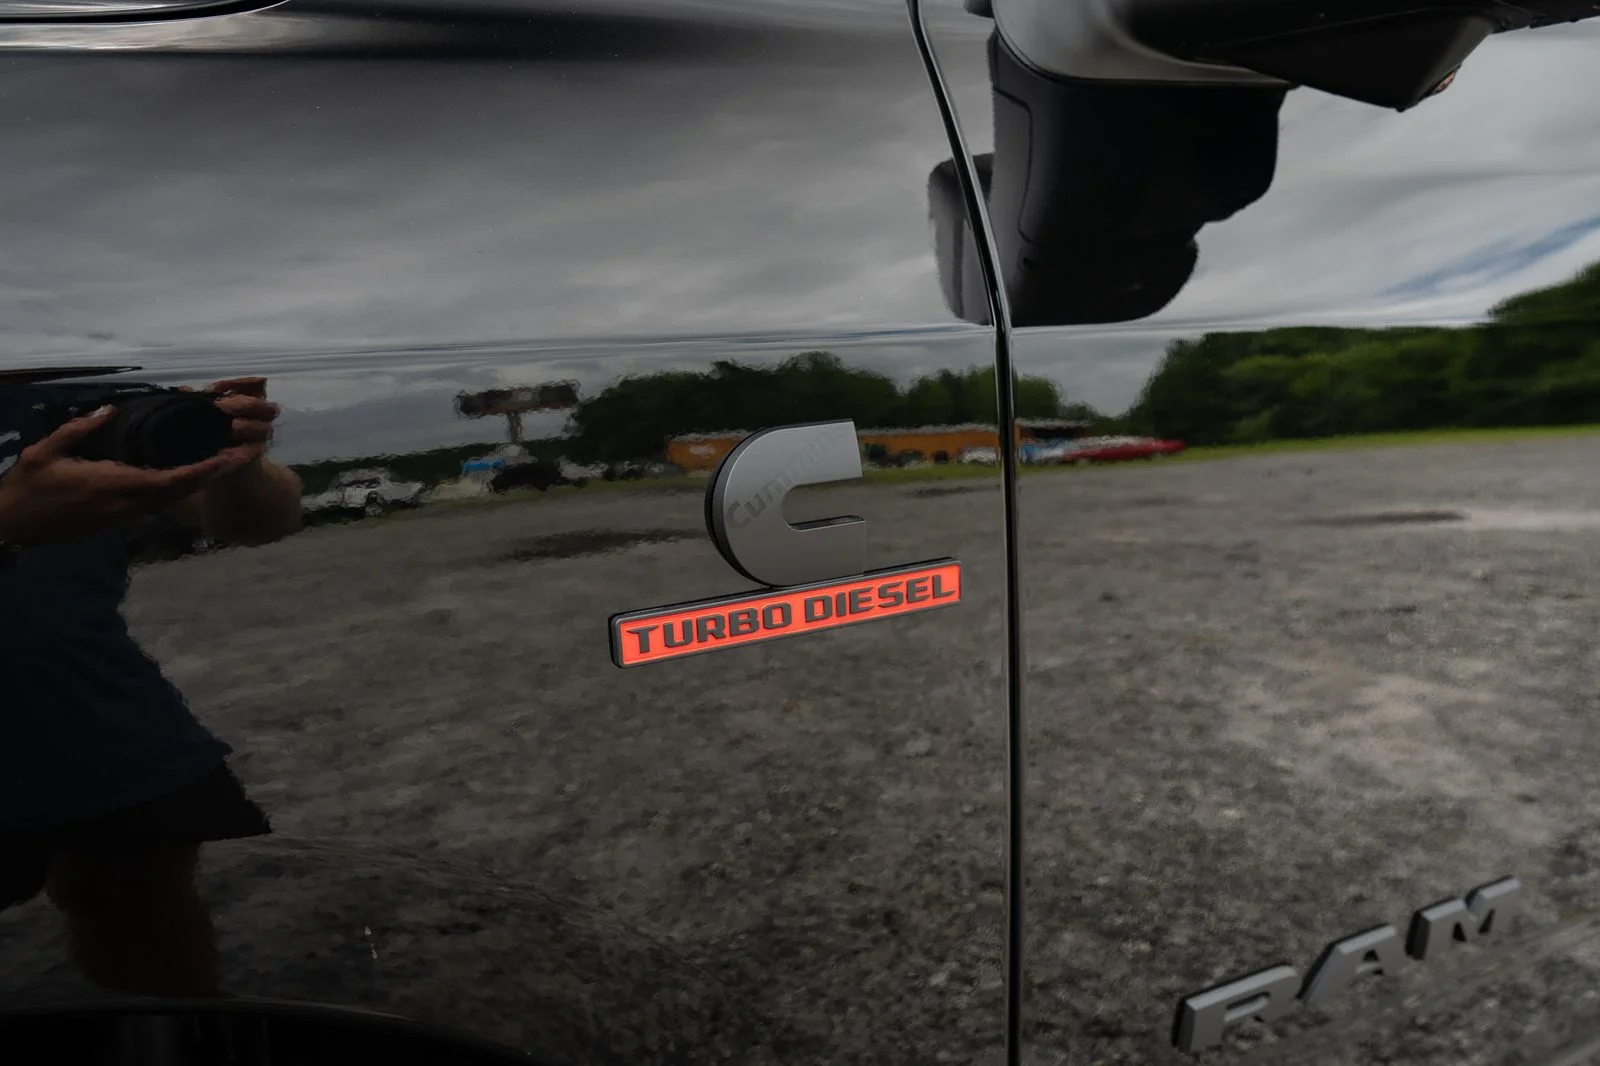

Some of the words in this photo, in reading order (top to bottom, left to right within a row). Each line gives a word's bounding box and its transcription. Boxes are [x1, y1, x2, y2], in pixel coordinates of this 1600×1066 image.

[627, 601, 793, 654] TURBO
[804, 574, 956, 624] DIESEL
[1172, 874, 1522, 1054] RAM
